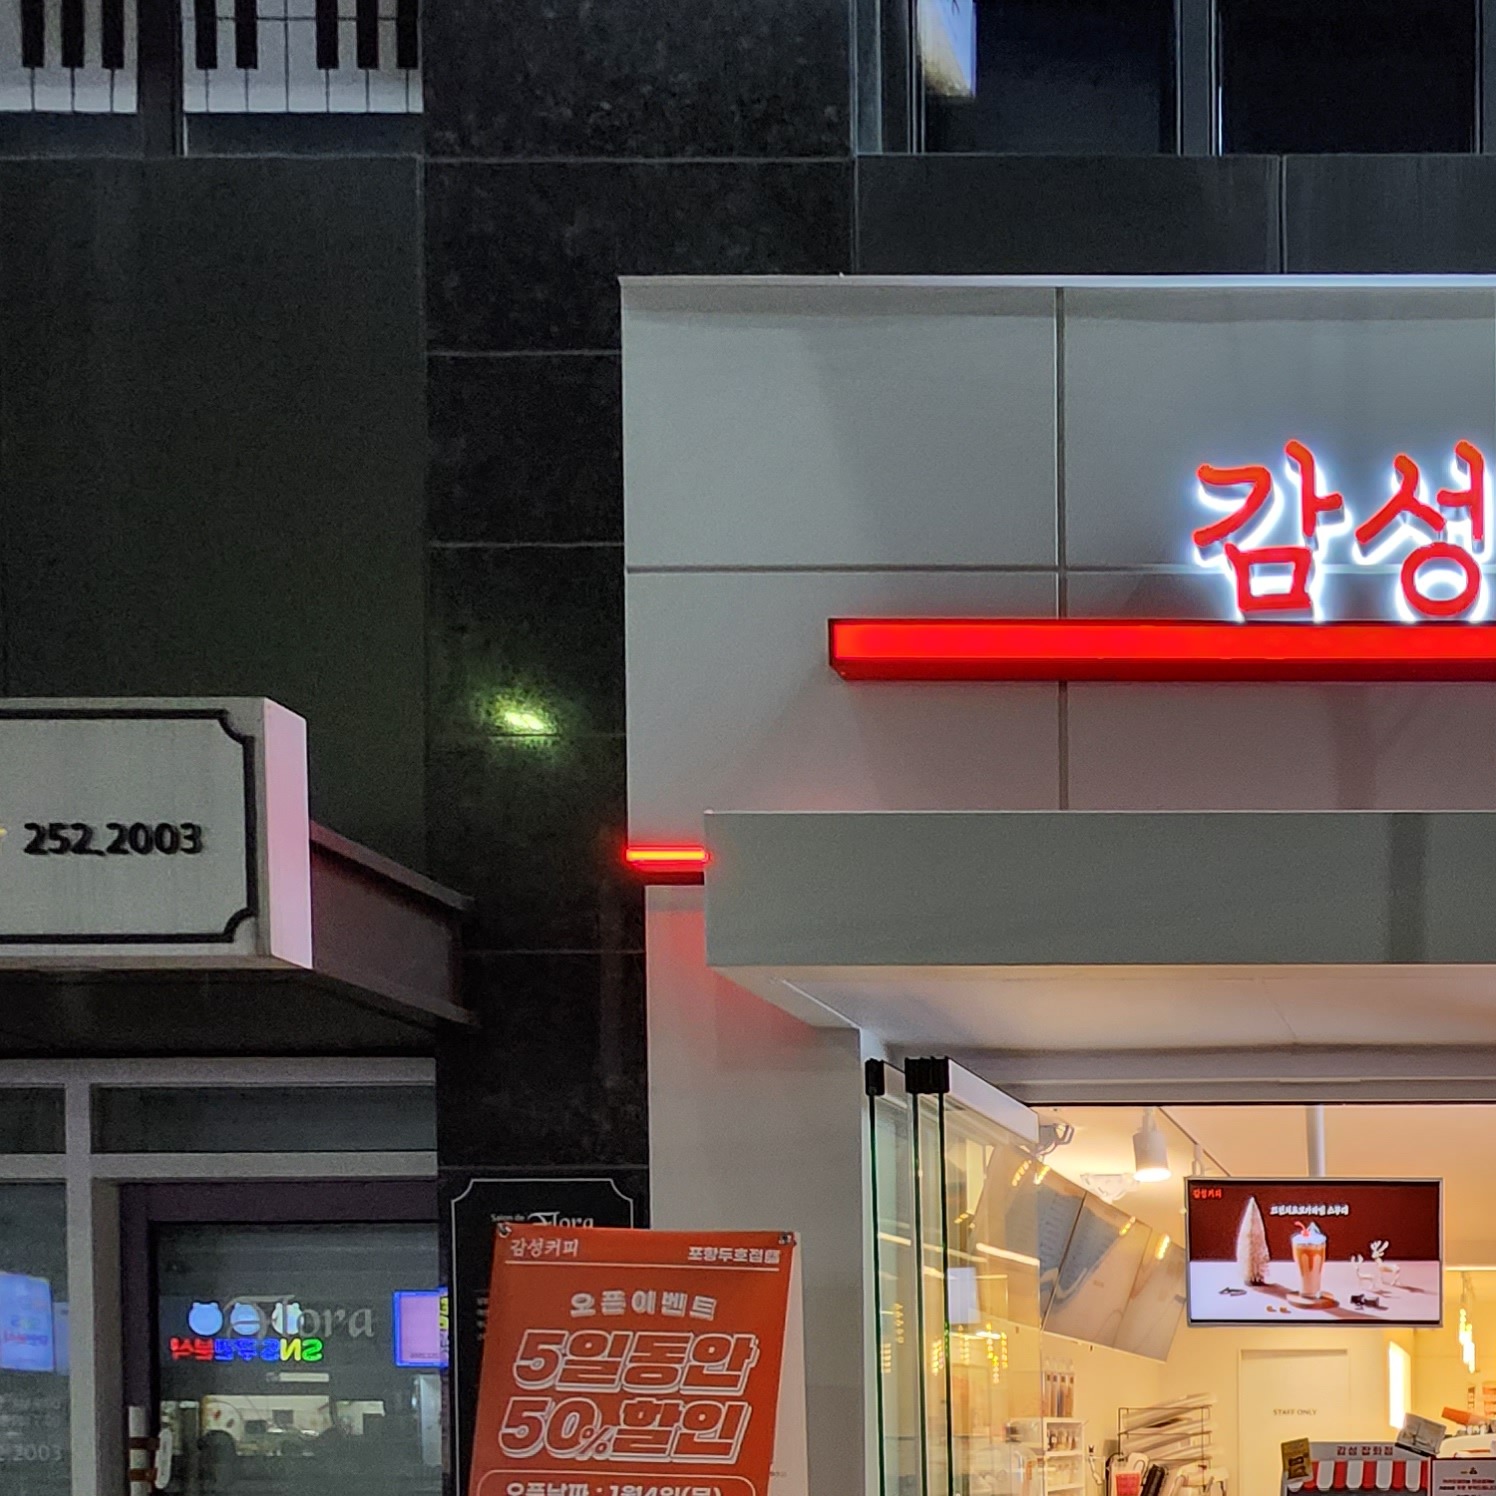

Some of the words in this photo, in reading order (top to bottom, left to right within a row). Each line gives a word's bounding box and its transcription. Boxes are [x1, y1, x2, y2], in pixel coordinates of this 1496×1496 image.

[510, 1237, 579, 1258] 감성커피
[569, 1290, 717, 1321] 오픈이벤트
[512, 1328, 760, 1396] 5일동안
[498, 1396, 752, 1464] 50%할인
